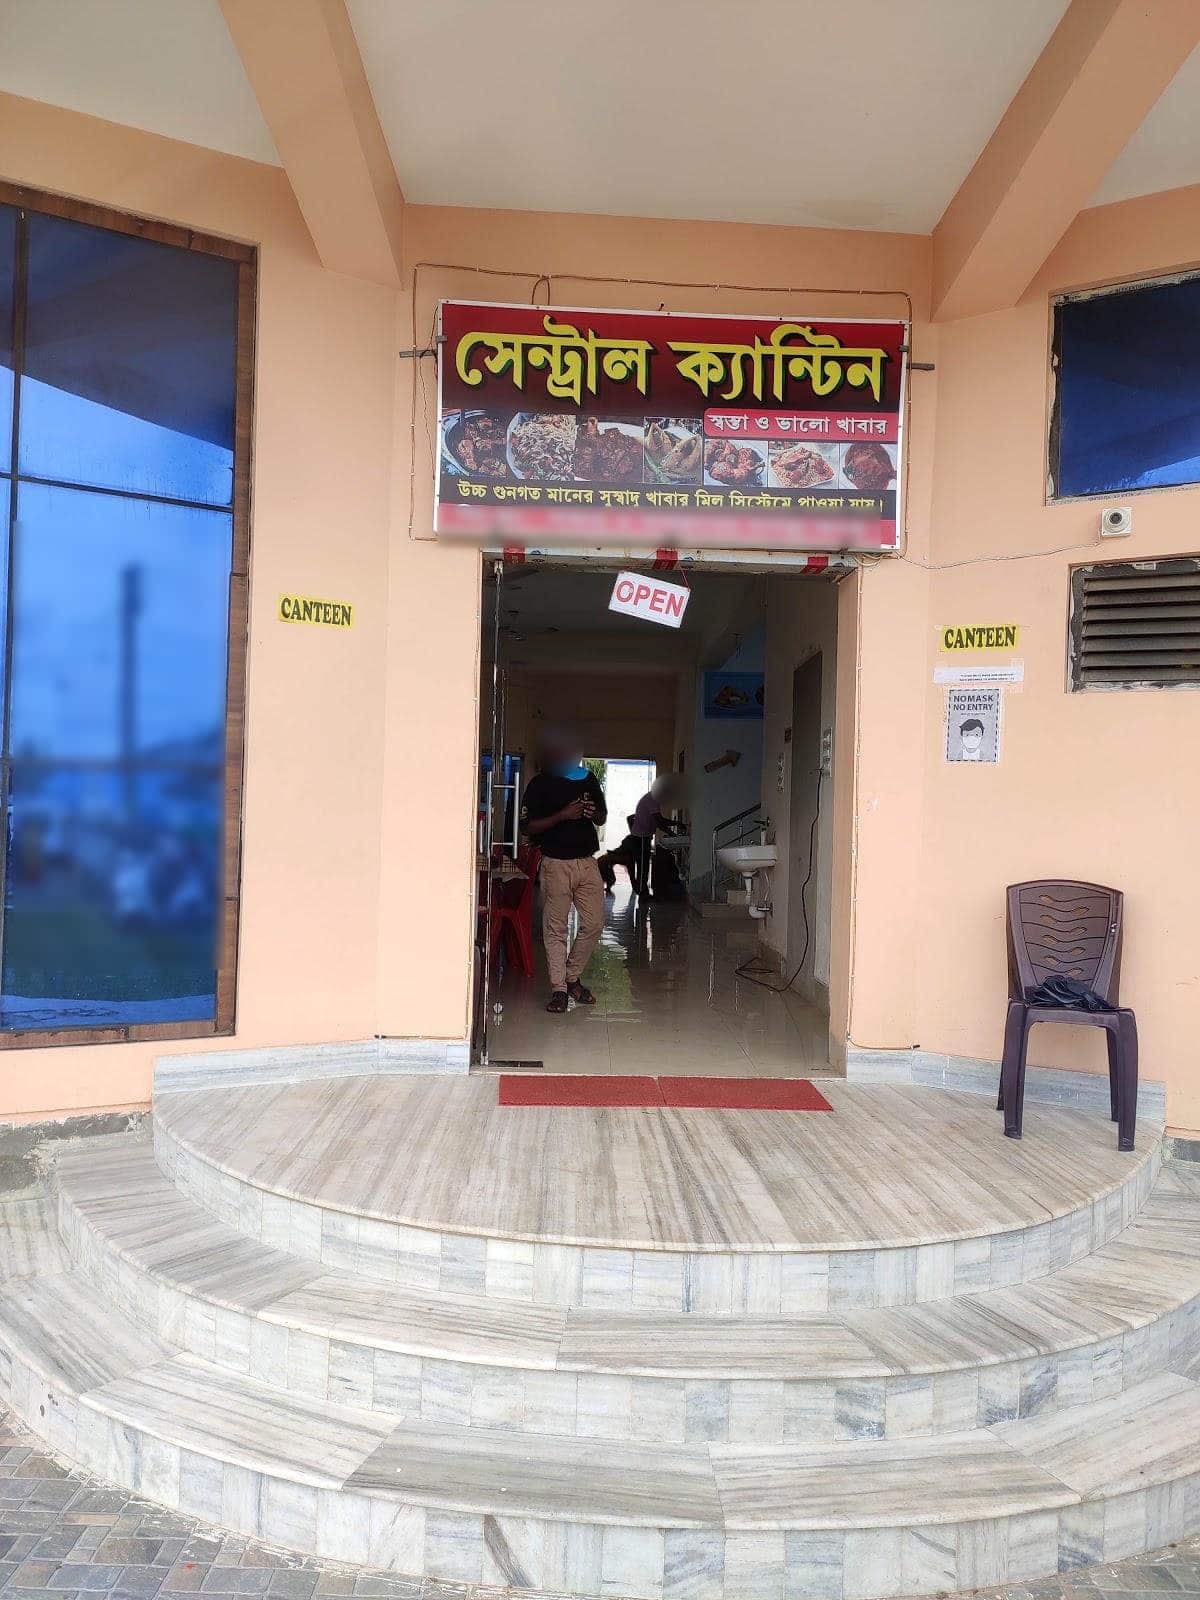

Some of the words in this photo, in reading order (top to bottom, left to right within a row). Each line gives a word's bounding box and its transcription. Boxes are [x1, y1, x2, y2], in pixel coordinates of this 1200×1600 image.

[456, 314, 653, 406] সেন্ট্রাল
[666, 324, 888, 403] ক্যান্টিন
[755, 417, 769, 431] ও
[775, 416, 830, 433] ভালো
[836, 416, 888, 434] খাবার
[457, 480, 488, 498] উচ্চ
[546, 486, 594, 504] মানের
[645, 490, 689, 508] খাবার
[694, 488, 725, 508] মিল
[280, 597, 352, 626] CANTEEN
[616, 580, 685, 618] OPEN
[944, 626, 1017, 649] CANTEEN
[953, 703, 966, 711] NO
[967, 703, 994, 711] ENTRY
